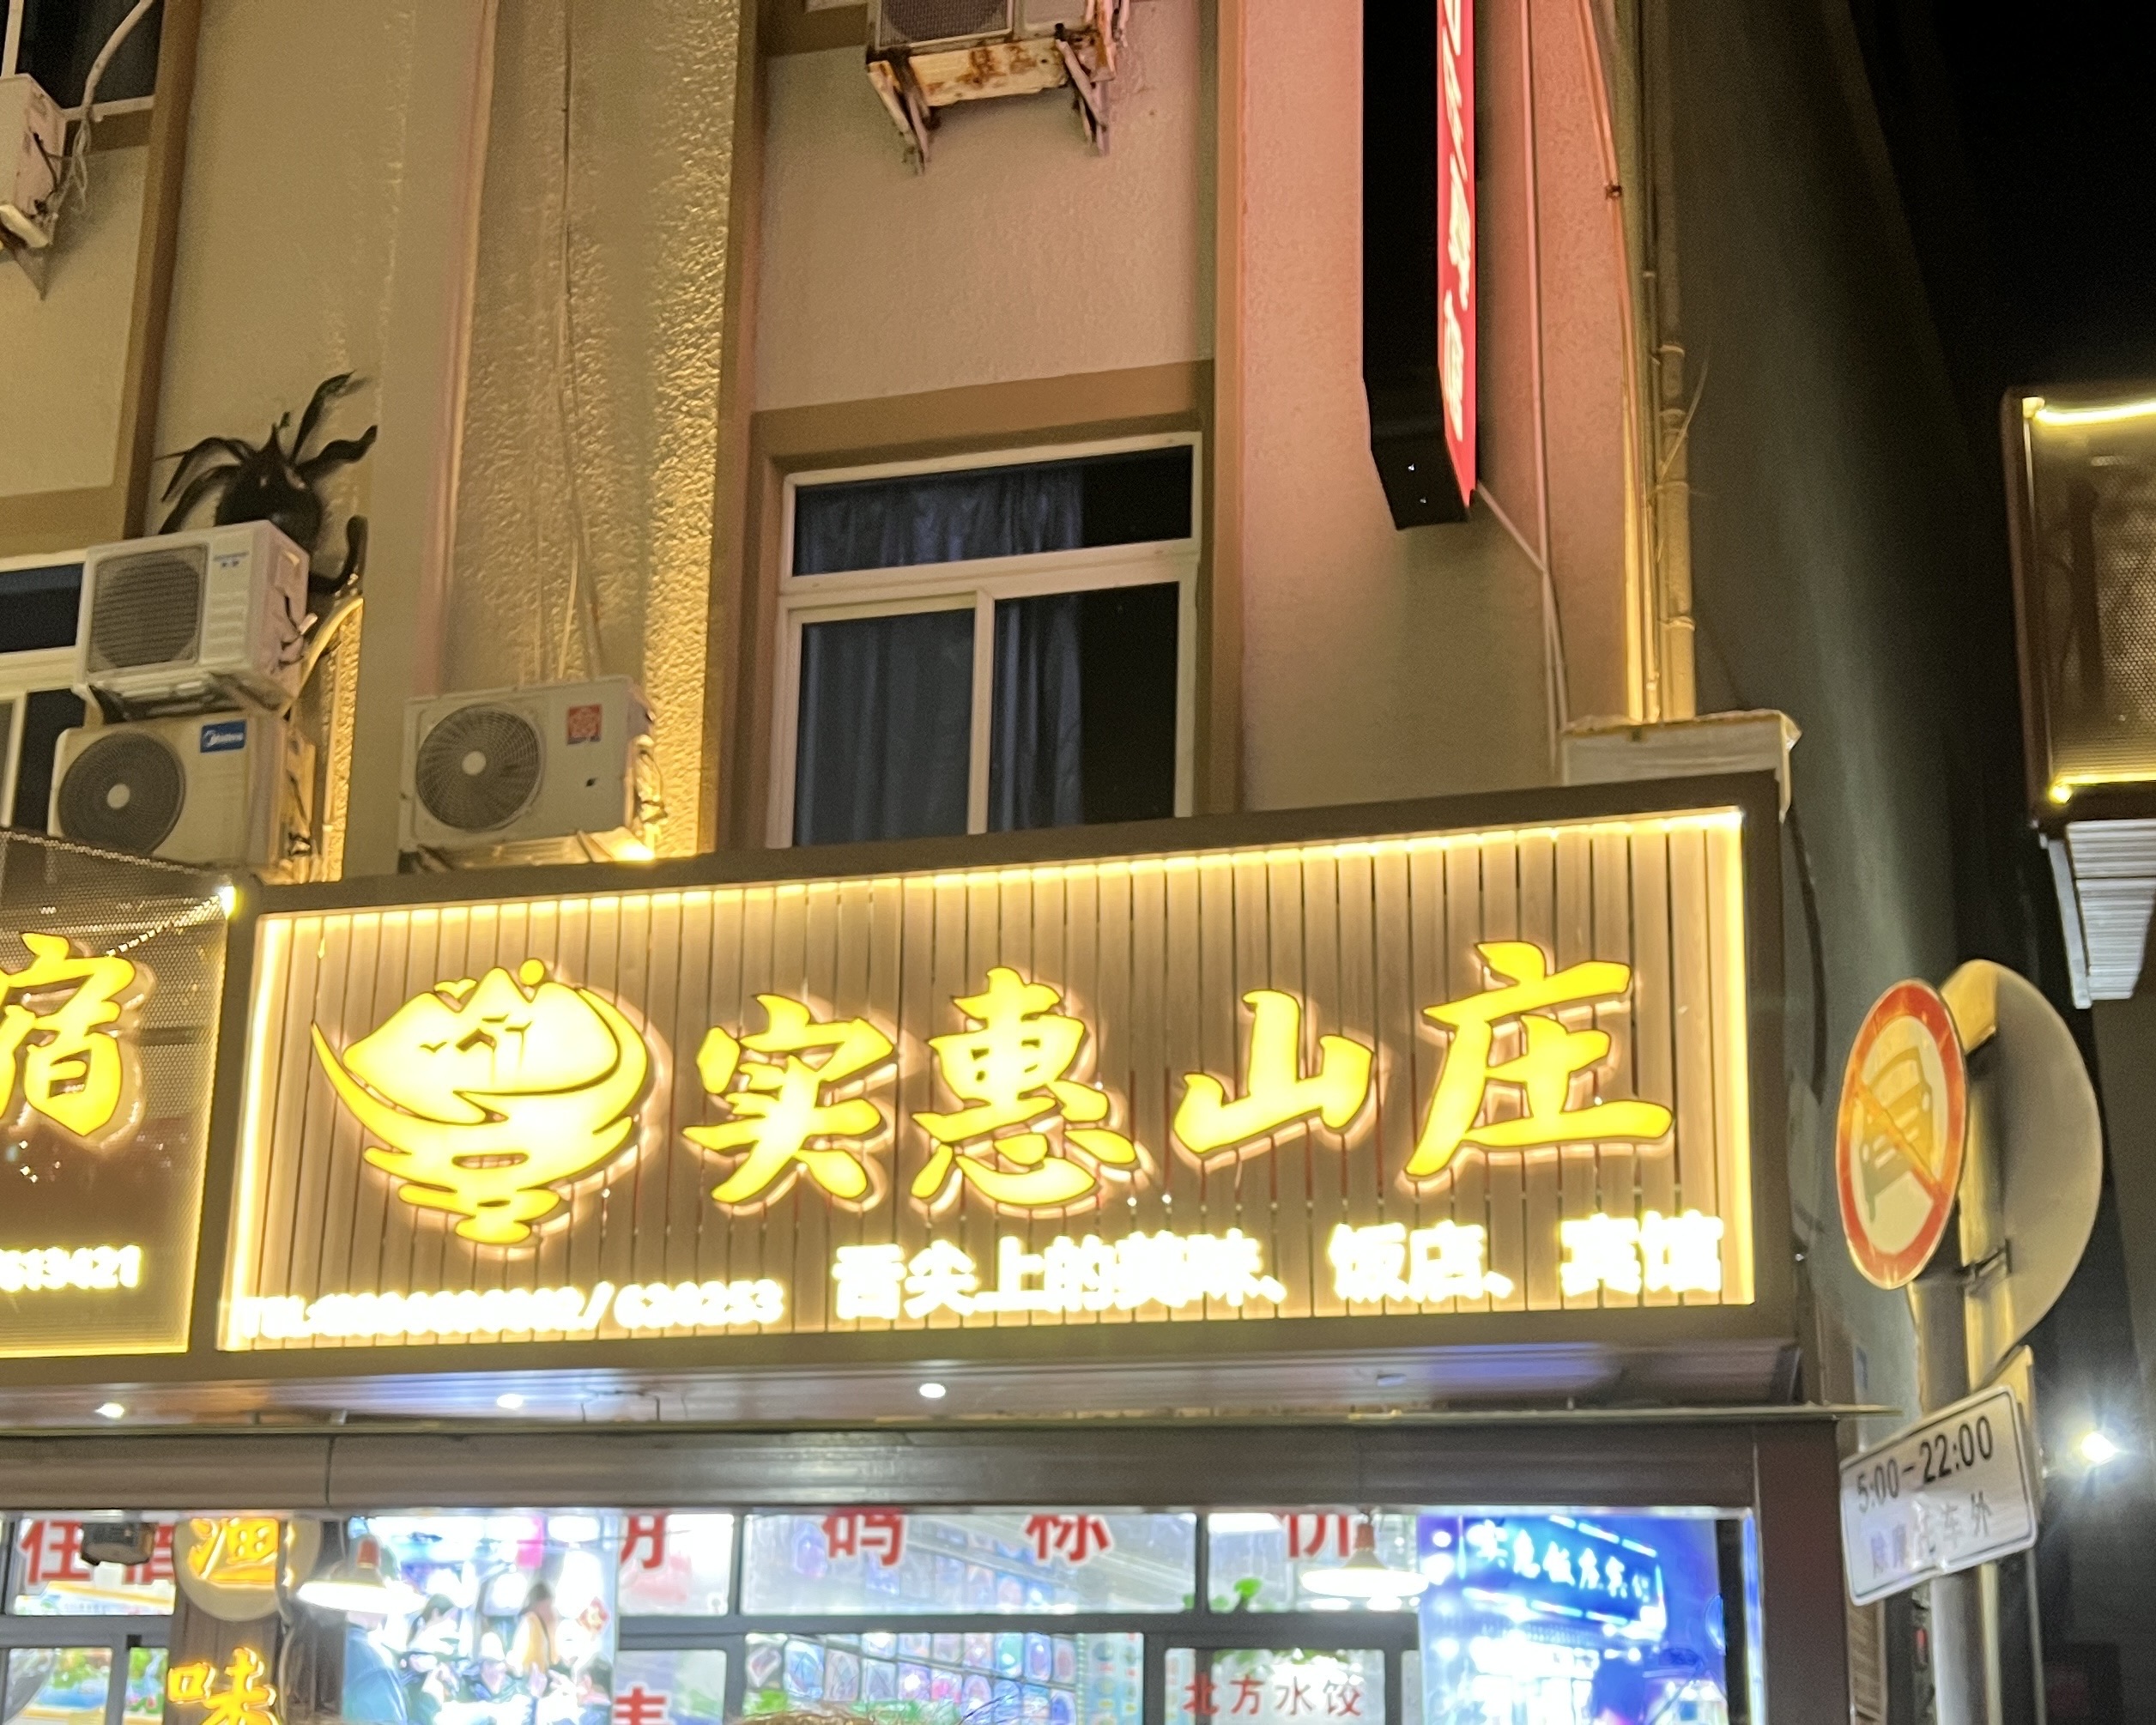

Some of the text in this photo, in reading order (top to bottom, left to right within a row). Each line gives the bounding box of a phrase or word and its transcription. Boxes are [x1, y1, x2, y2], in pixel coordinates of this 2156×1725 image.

[0, 932, 136, 1137] 宿
[682, 941, 1674, 1207] 实惠山庄
[1856, 1415, 1994, 1513] 5:00-22:00
[1183, 1674, 1362, 1716] 北方水饺
